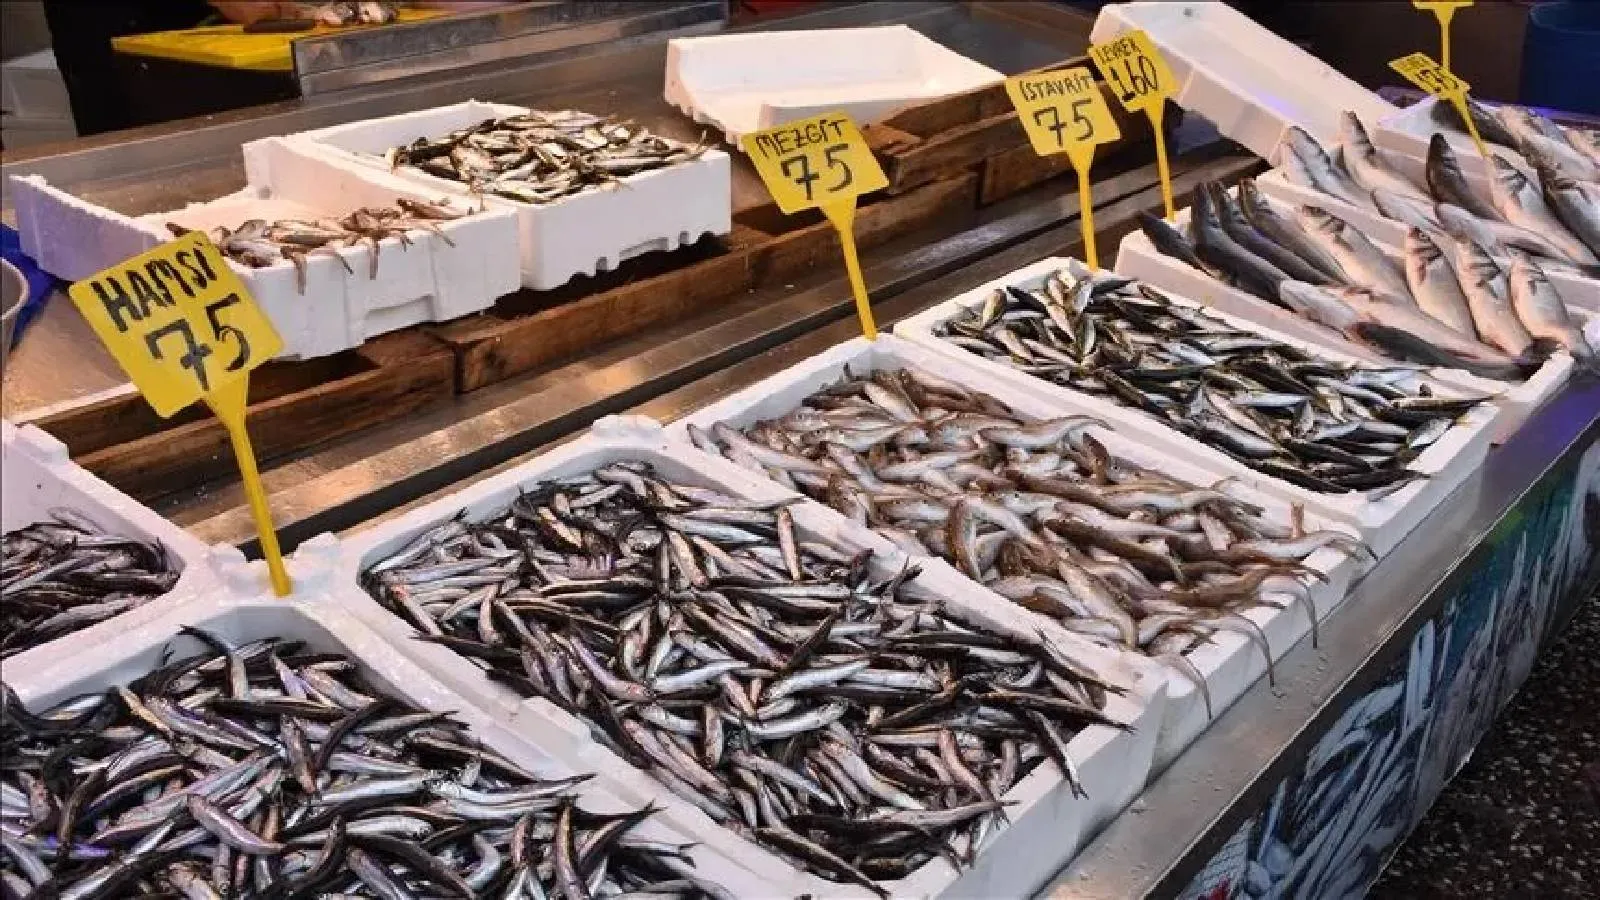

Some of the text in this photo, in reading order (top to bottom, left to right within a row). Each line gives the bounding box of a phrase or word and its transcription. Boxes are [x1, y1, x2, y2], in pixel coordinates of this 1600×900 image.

[1109, 56, 1158, 102] 160
[1033, 98, 1094, 147] 75
[780, 143, 853, 200] 75
[144, 293, 251, 391] 75
